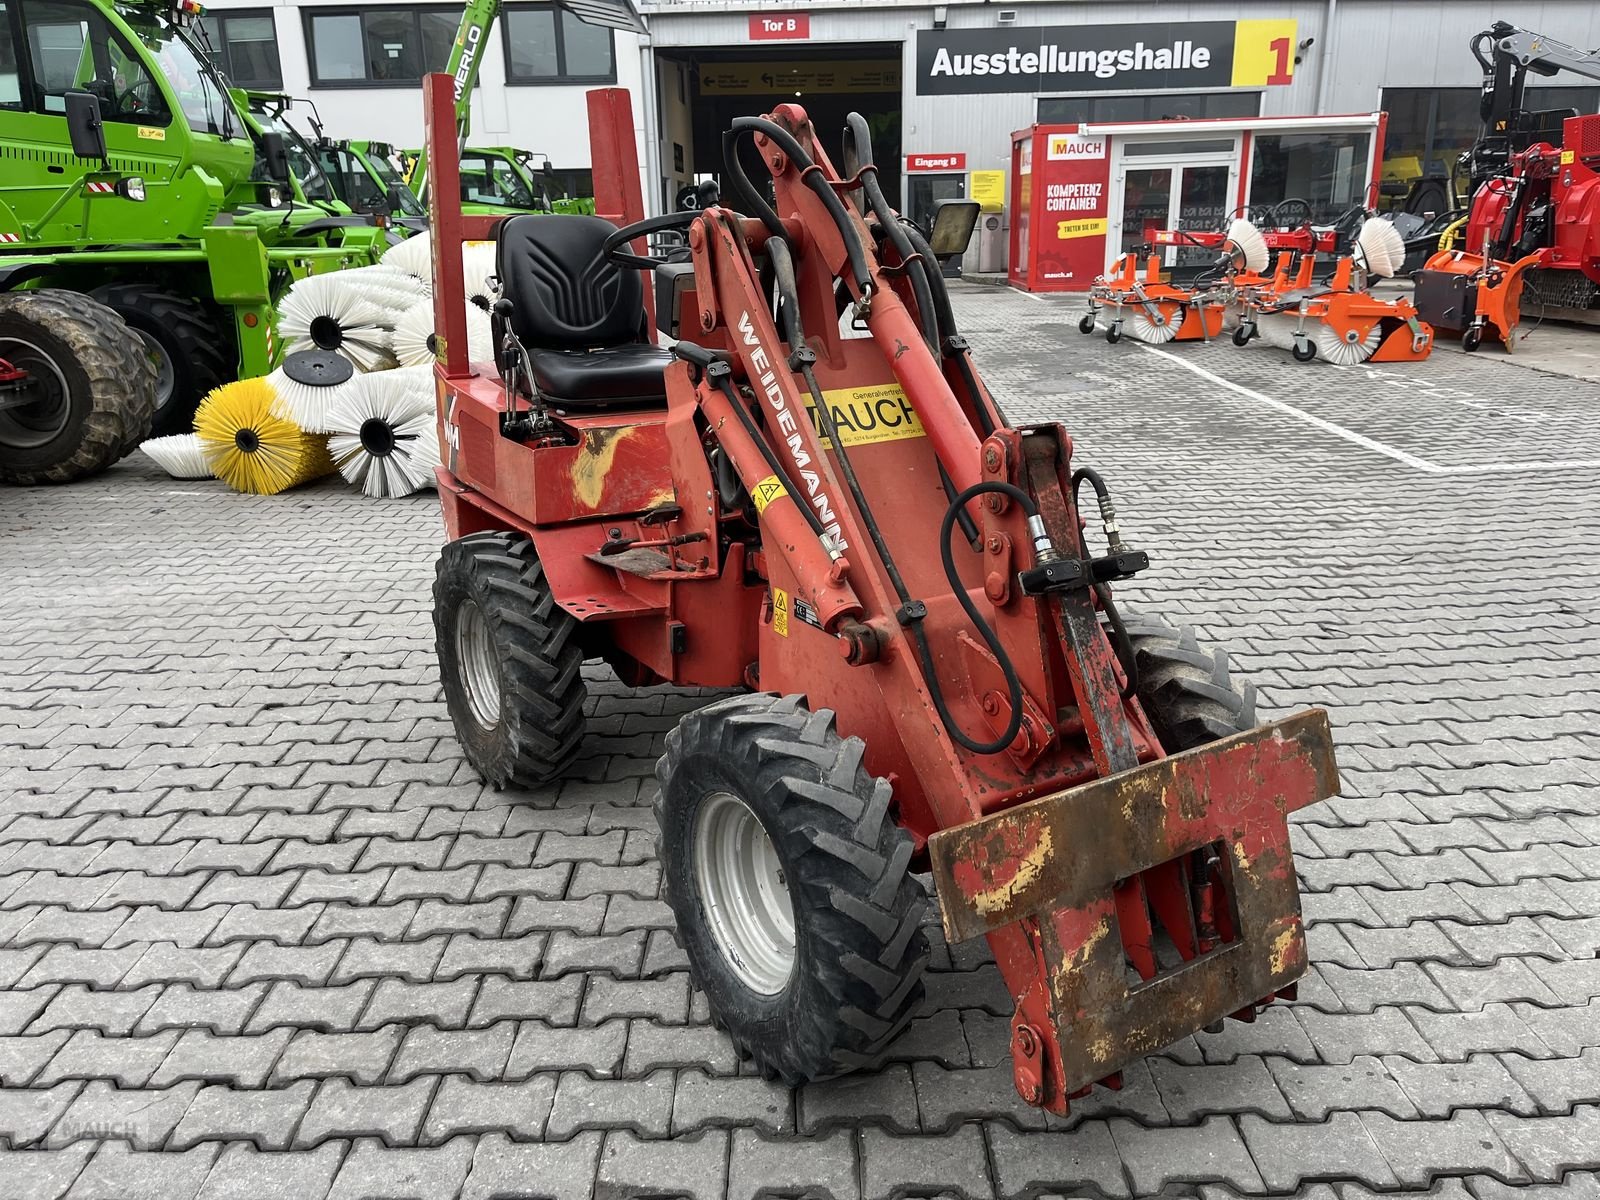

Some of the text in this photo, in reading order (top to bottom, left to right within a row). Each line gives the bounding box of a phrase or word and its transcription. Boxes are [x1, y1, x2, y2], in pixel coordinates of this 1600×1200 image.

[762, 19, 796, 32] Tor B
[454, 25, 481, 100] MERLO
[930, 37, 1293, 86] Ausstellungshalle 1
[1056, 142, 1102, 155] MAUCH
[915, 157, 957, 167] Eingang B
[1047, 183, 1102, 198] KOMPETENZ
[1046, 197, 1097, 211] CONTAINER
[737, 309, 849, 553] WEIDEMANN
